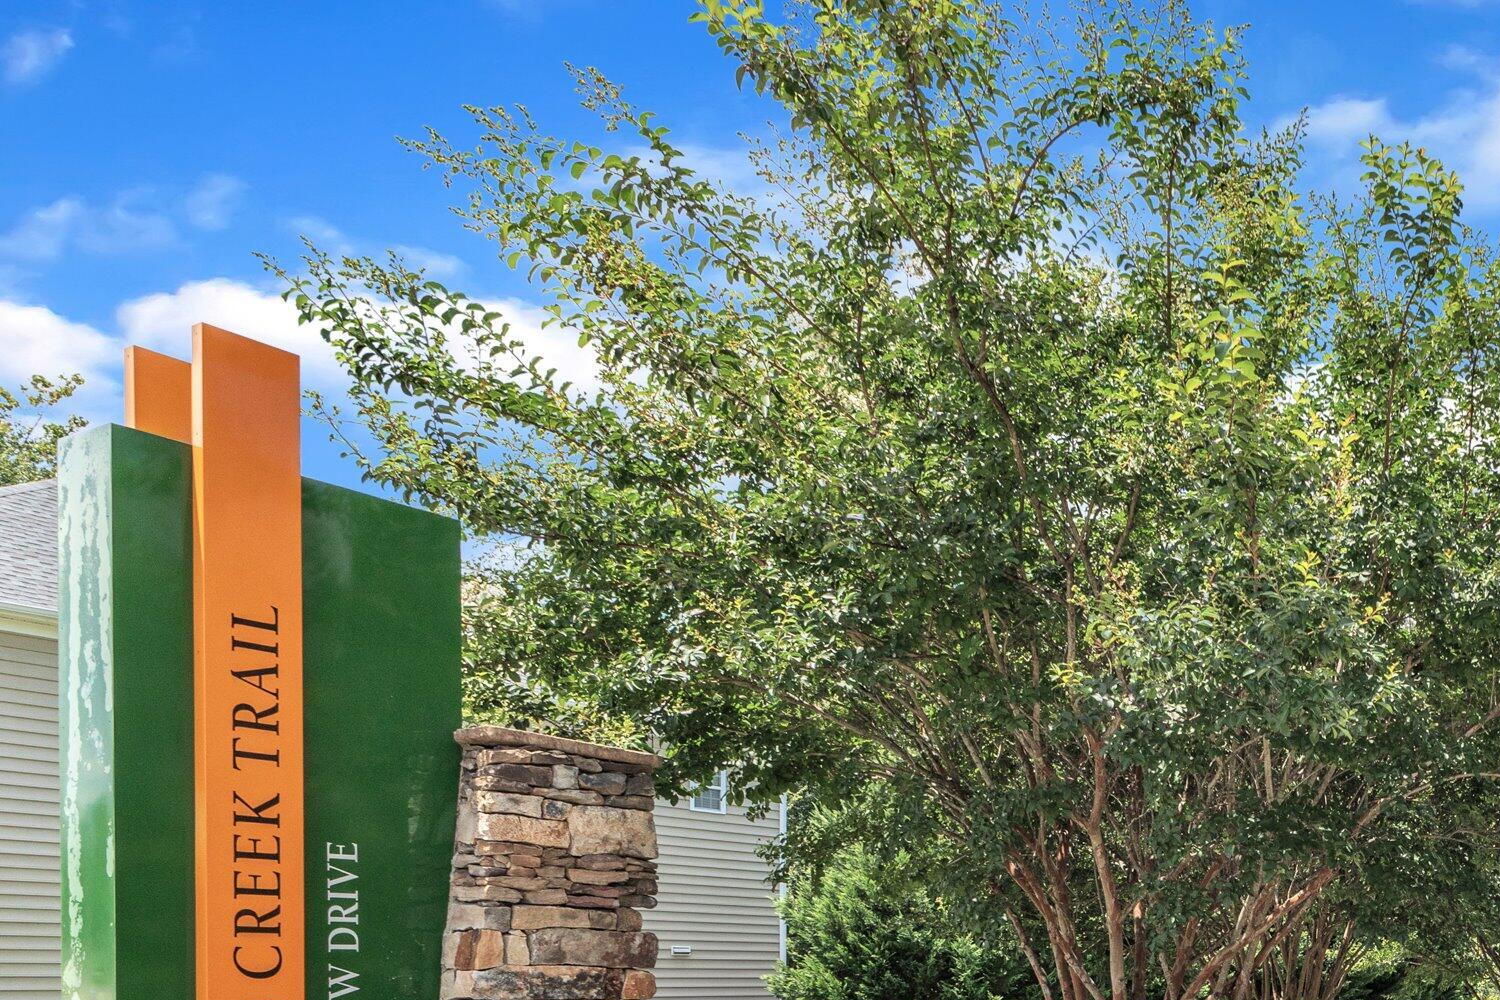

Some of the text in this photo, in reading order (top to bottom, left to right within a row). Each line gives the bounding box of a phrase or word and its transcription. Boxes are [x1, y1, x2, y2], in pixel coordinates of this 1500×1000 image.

[231, 605, 279, 771] TRAIL
[233, 791, 282, 979] CREEK
[327, 842, 359, 953] DRIVE
